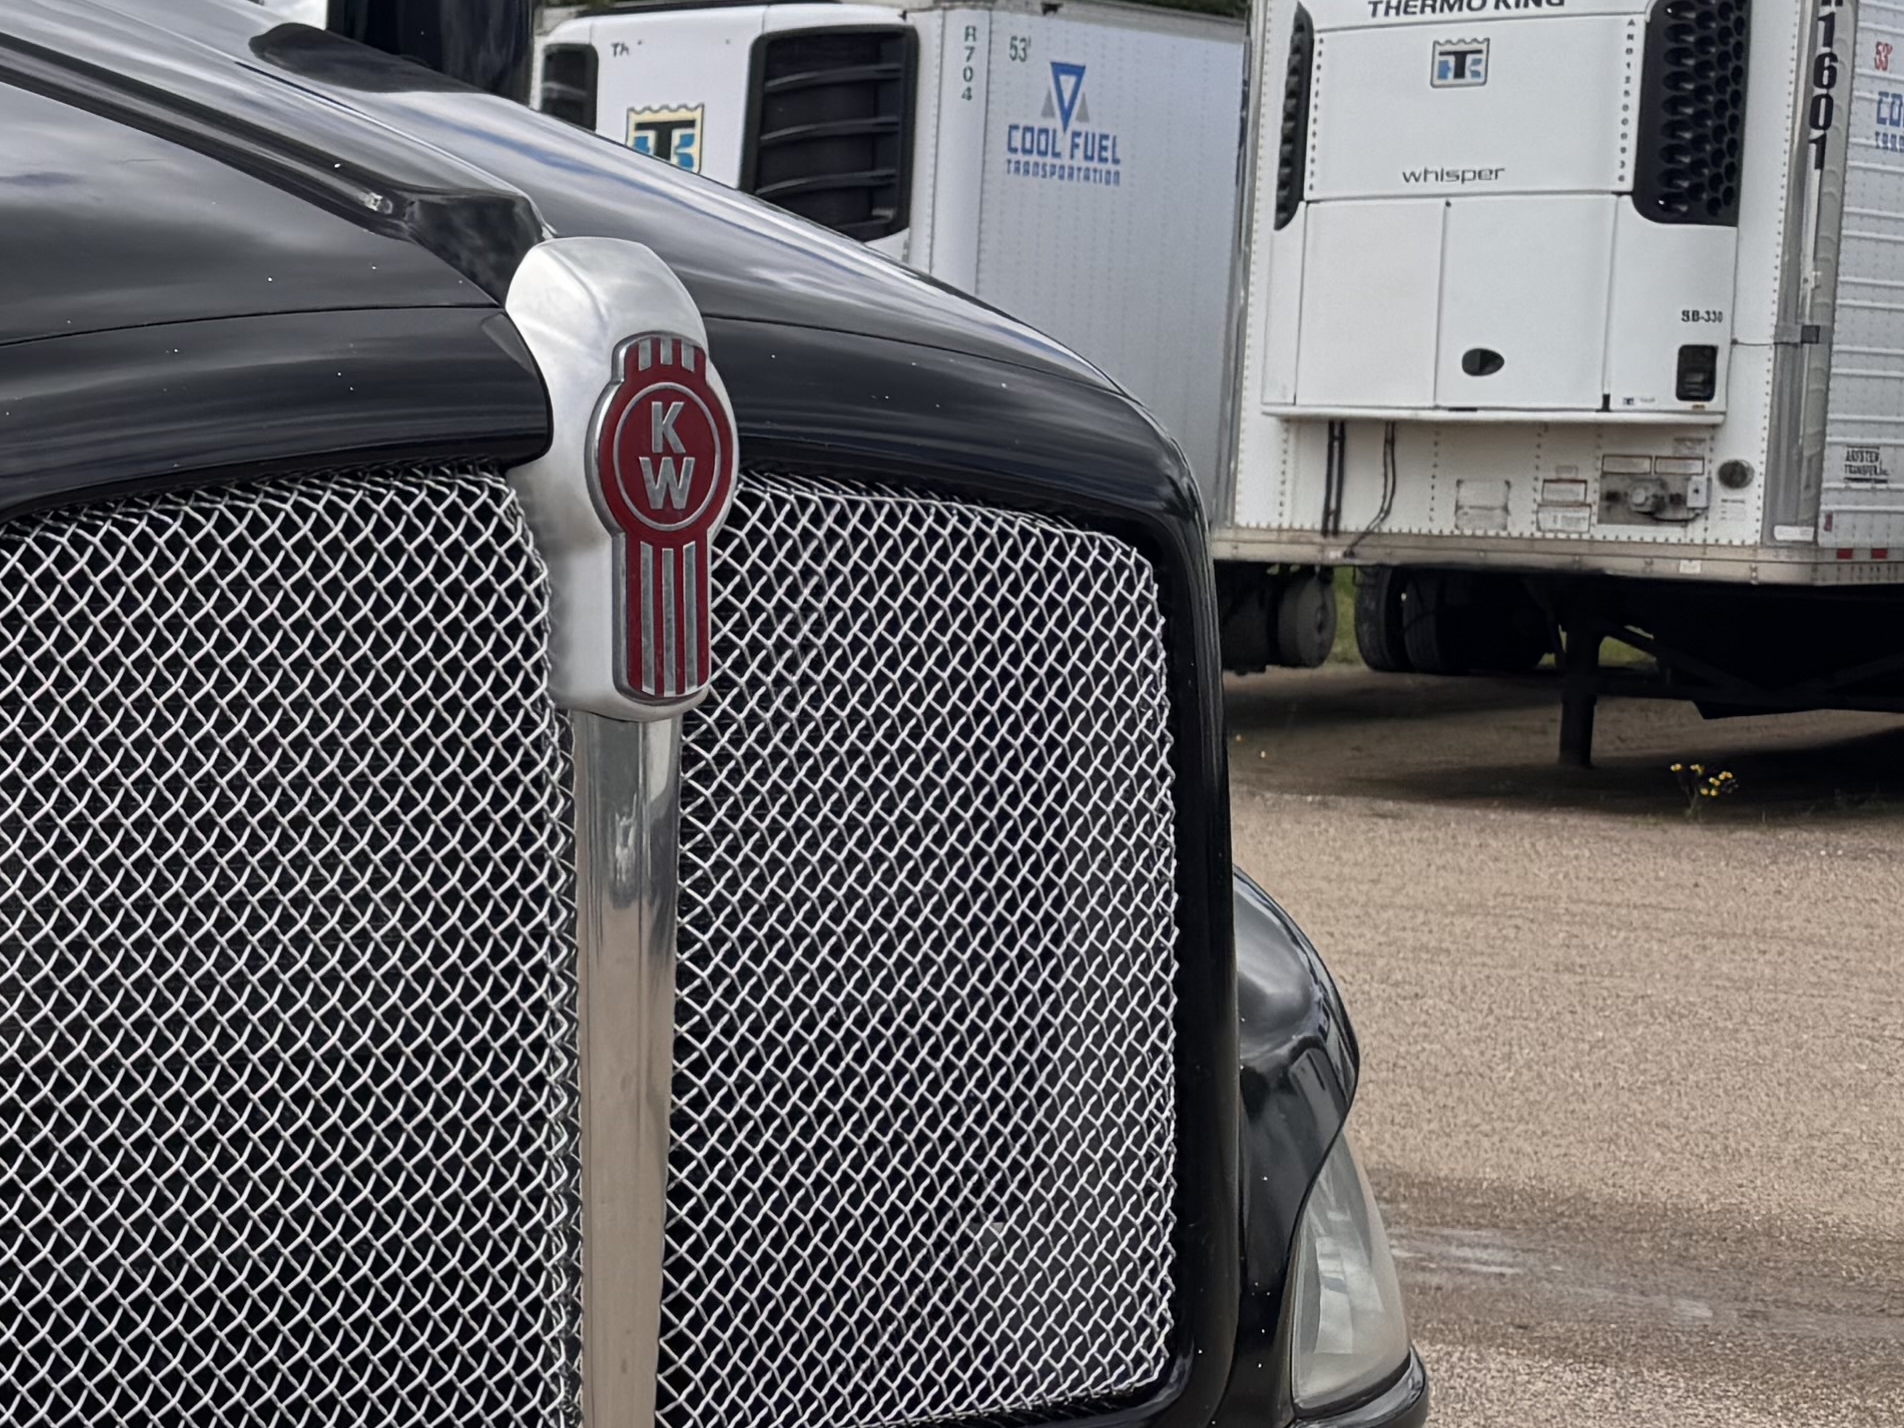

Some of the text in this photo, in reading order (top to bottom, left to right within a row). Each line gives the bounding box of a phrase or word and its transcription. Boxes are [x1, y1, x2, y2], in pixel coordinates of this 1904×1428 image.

[1007, 124, 1121, 166] COOL FUEL
[1006, 158, 1121, 187] TRANSPORTATION
[1402, 166, 1506, 185] whisper
